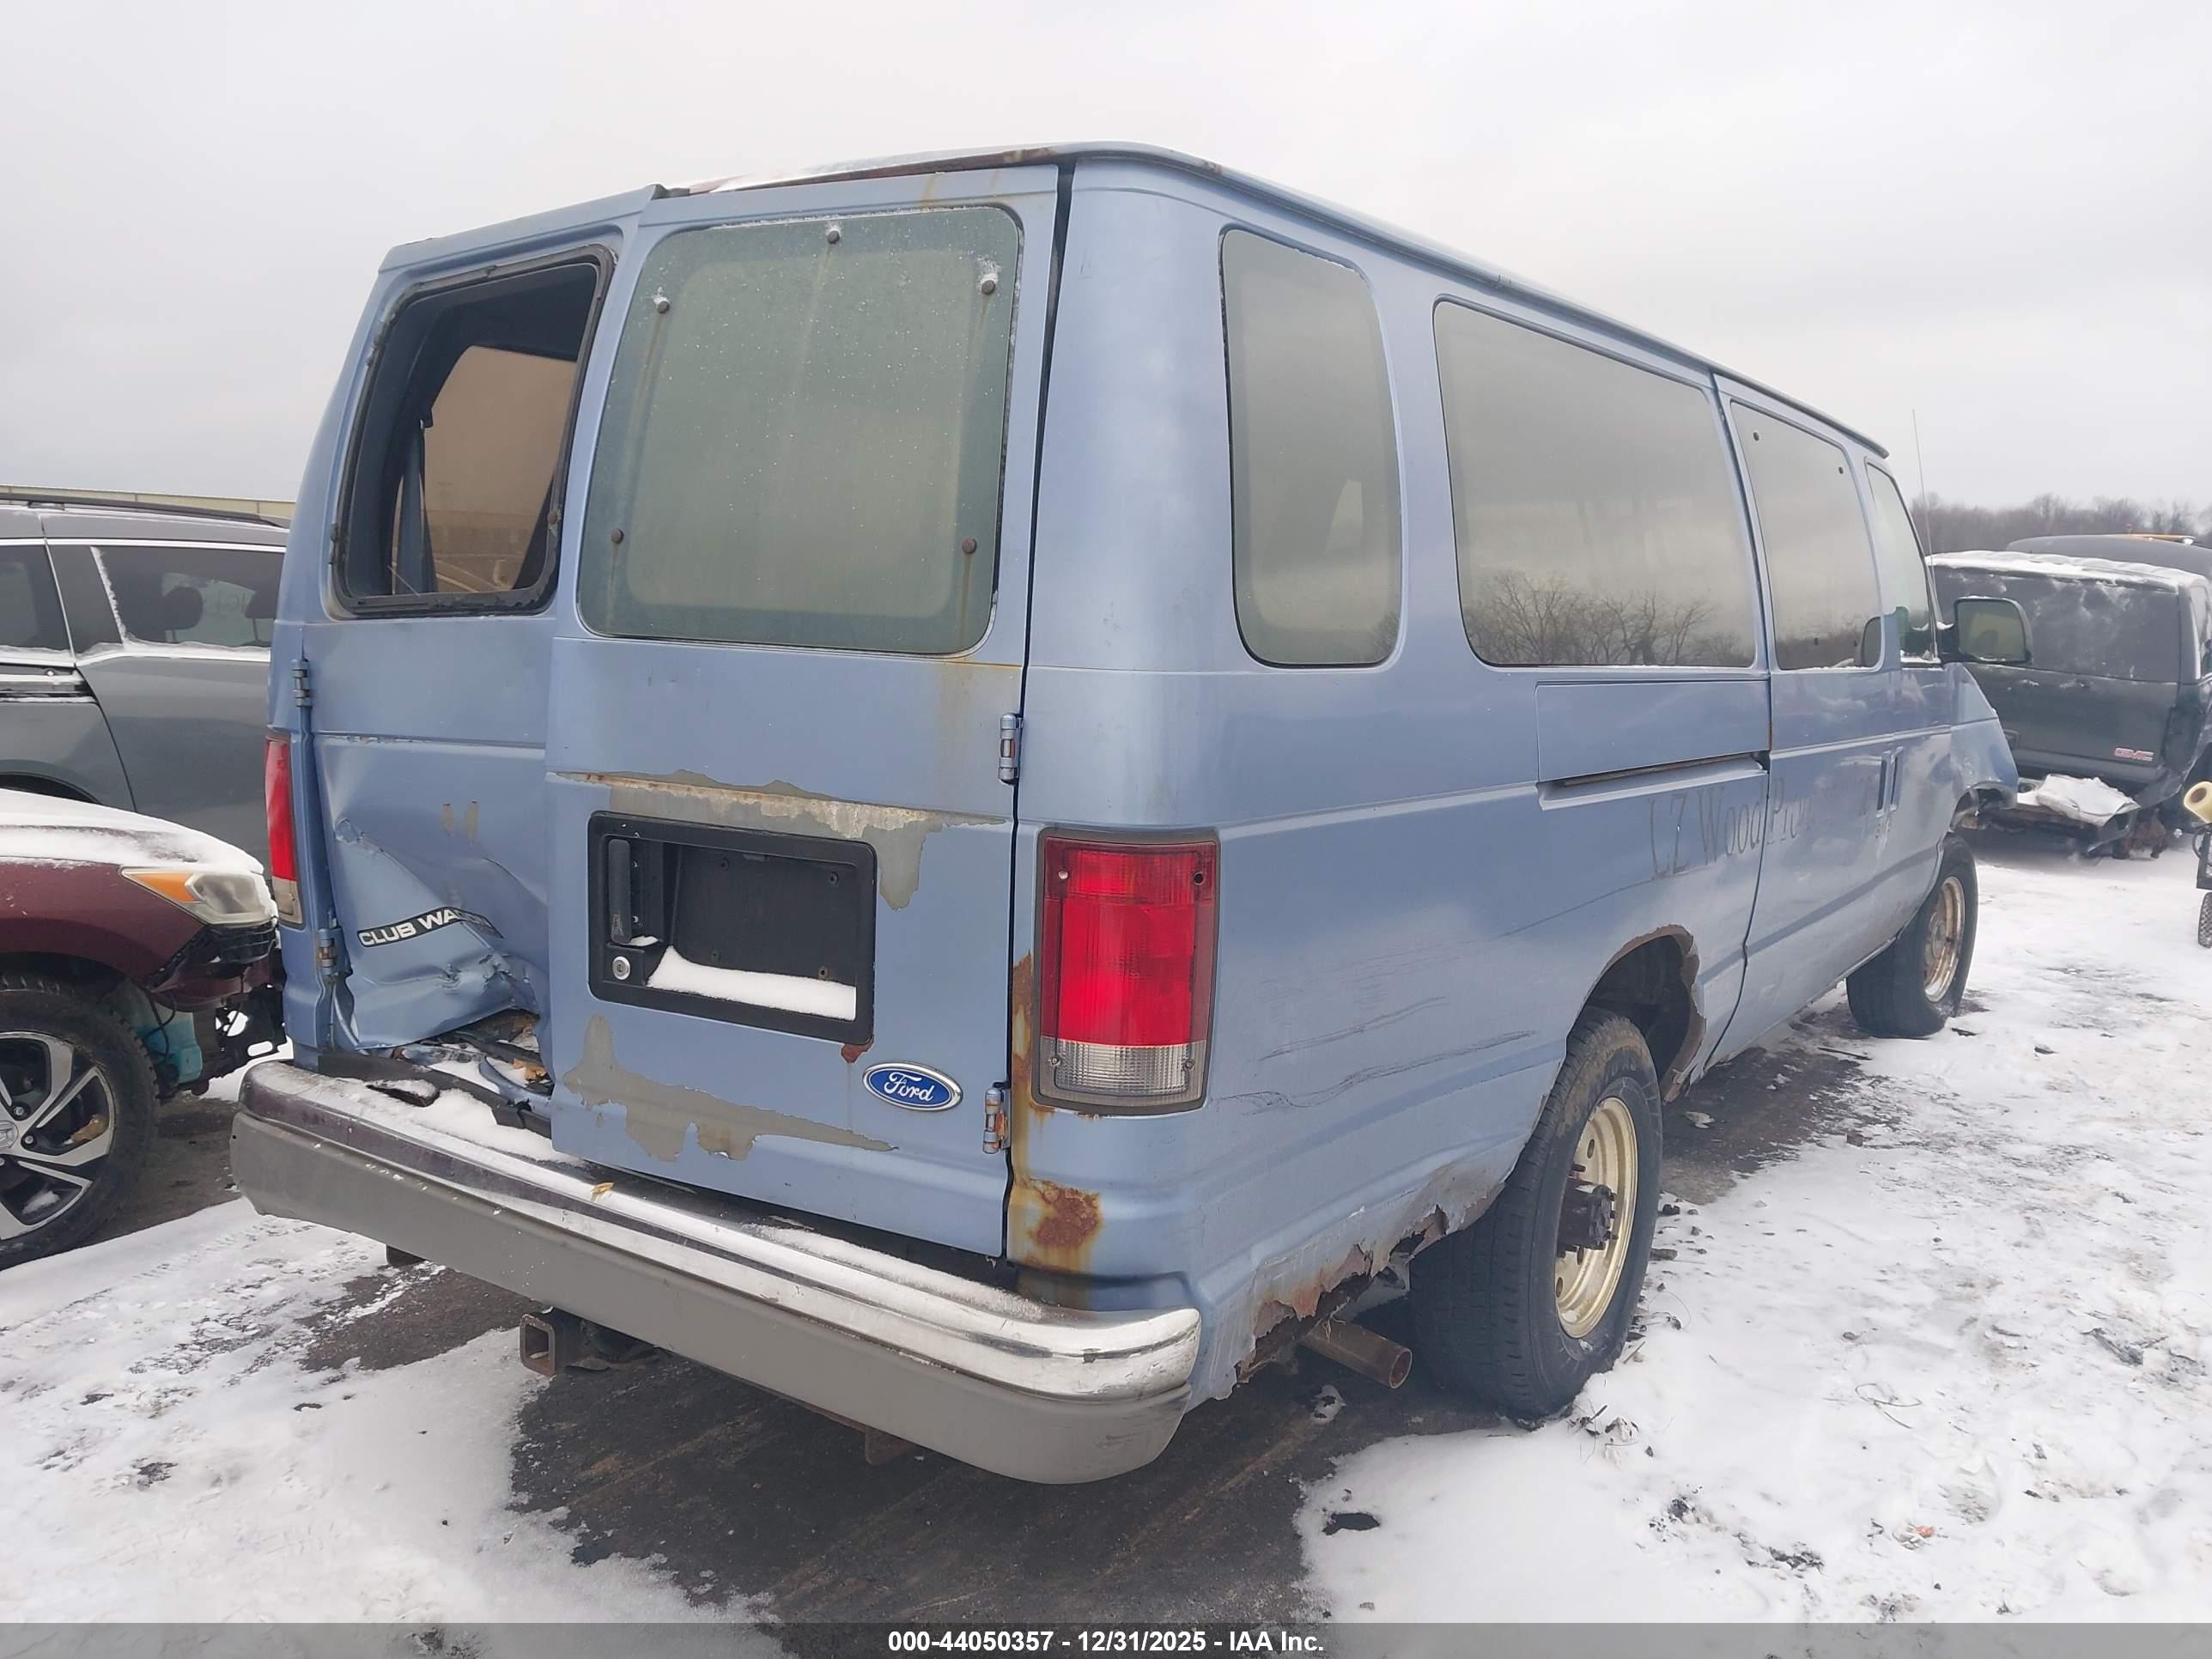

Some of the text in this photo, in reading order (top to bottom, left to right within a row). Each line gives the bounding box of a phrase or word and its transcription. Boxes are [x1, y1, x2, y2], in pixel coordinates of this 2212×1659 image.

[2114, 747, 2154, 762] GMC
[358, 921, 416, 946] CLUB
[883, 1072, 935, 1102] Ford
